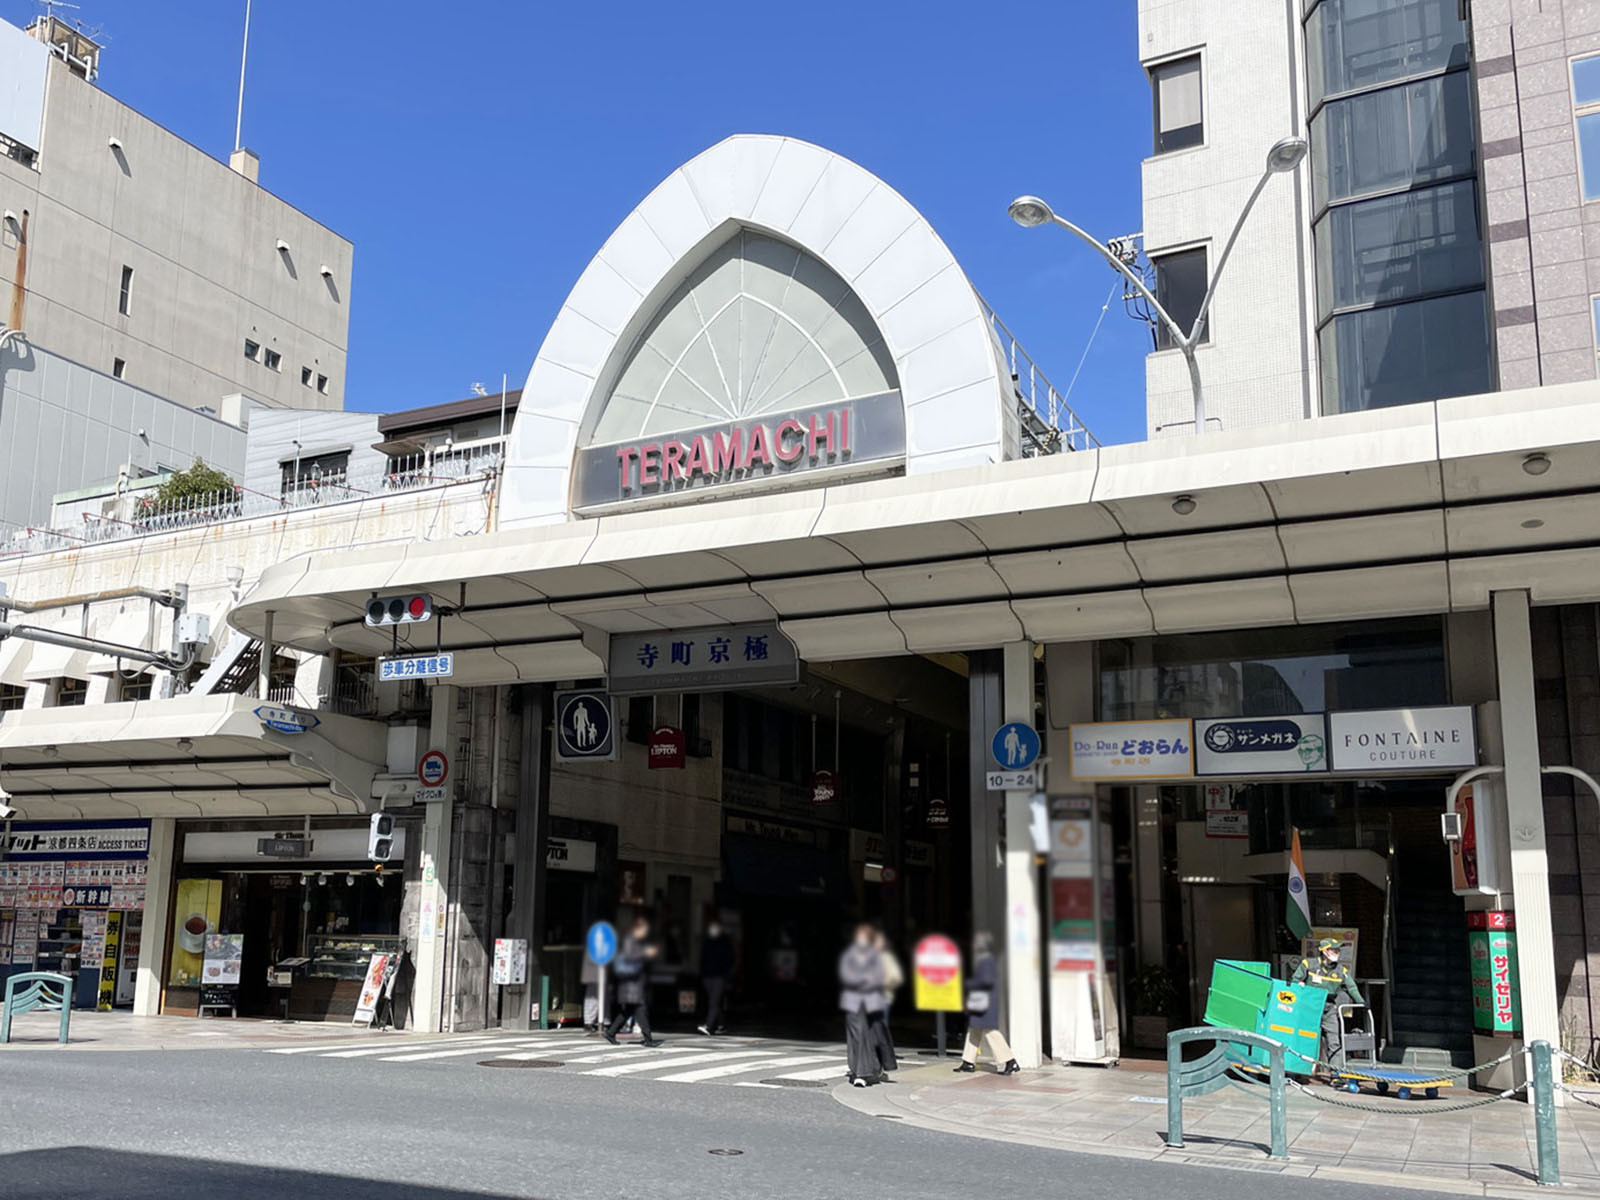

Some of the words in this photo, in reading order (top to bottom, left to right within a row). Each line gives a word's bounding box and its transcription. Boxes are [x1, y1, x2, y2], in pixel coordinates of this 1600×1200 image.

[616, 408, 854, 490] TERAMACHI
[636, 634, 769, 669] 寺町京極
[382, 657, 449, 677] 歩車分離信号
[1121, 738, 1189, 756] どおらん
[1237, 732, 1296, 746] サンメガネ
[1345, 729, 1461, 748] FONTAINE
[1369, 749, 1437, 762] COUTURE
[49, 836, 98, 850] 京都四条店
[98, 840, 123, 850] ACCESS
[124, 838, 148, 849] TICKET
[75, 889, 110, 905] 新幹線
[1493, 956, 1512, 1023] サイゼリヤ
